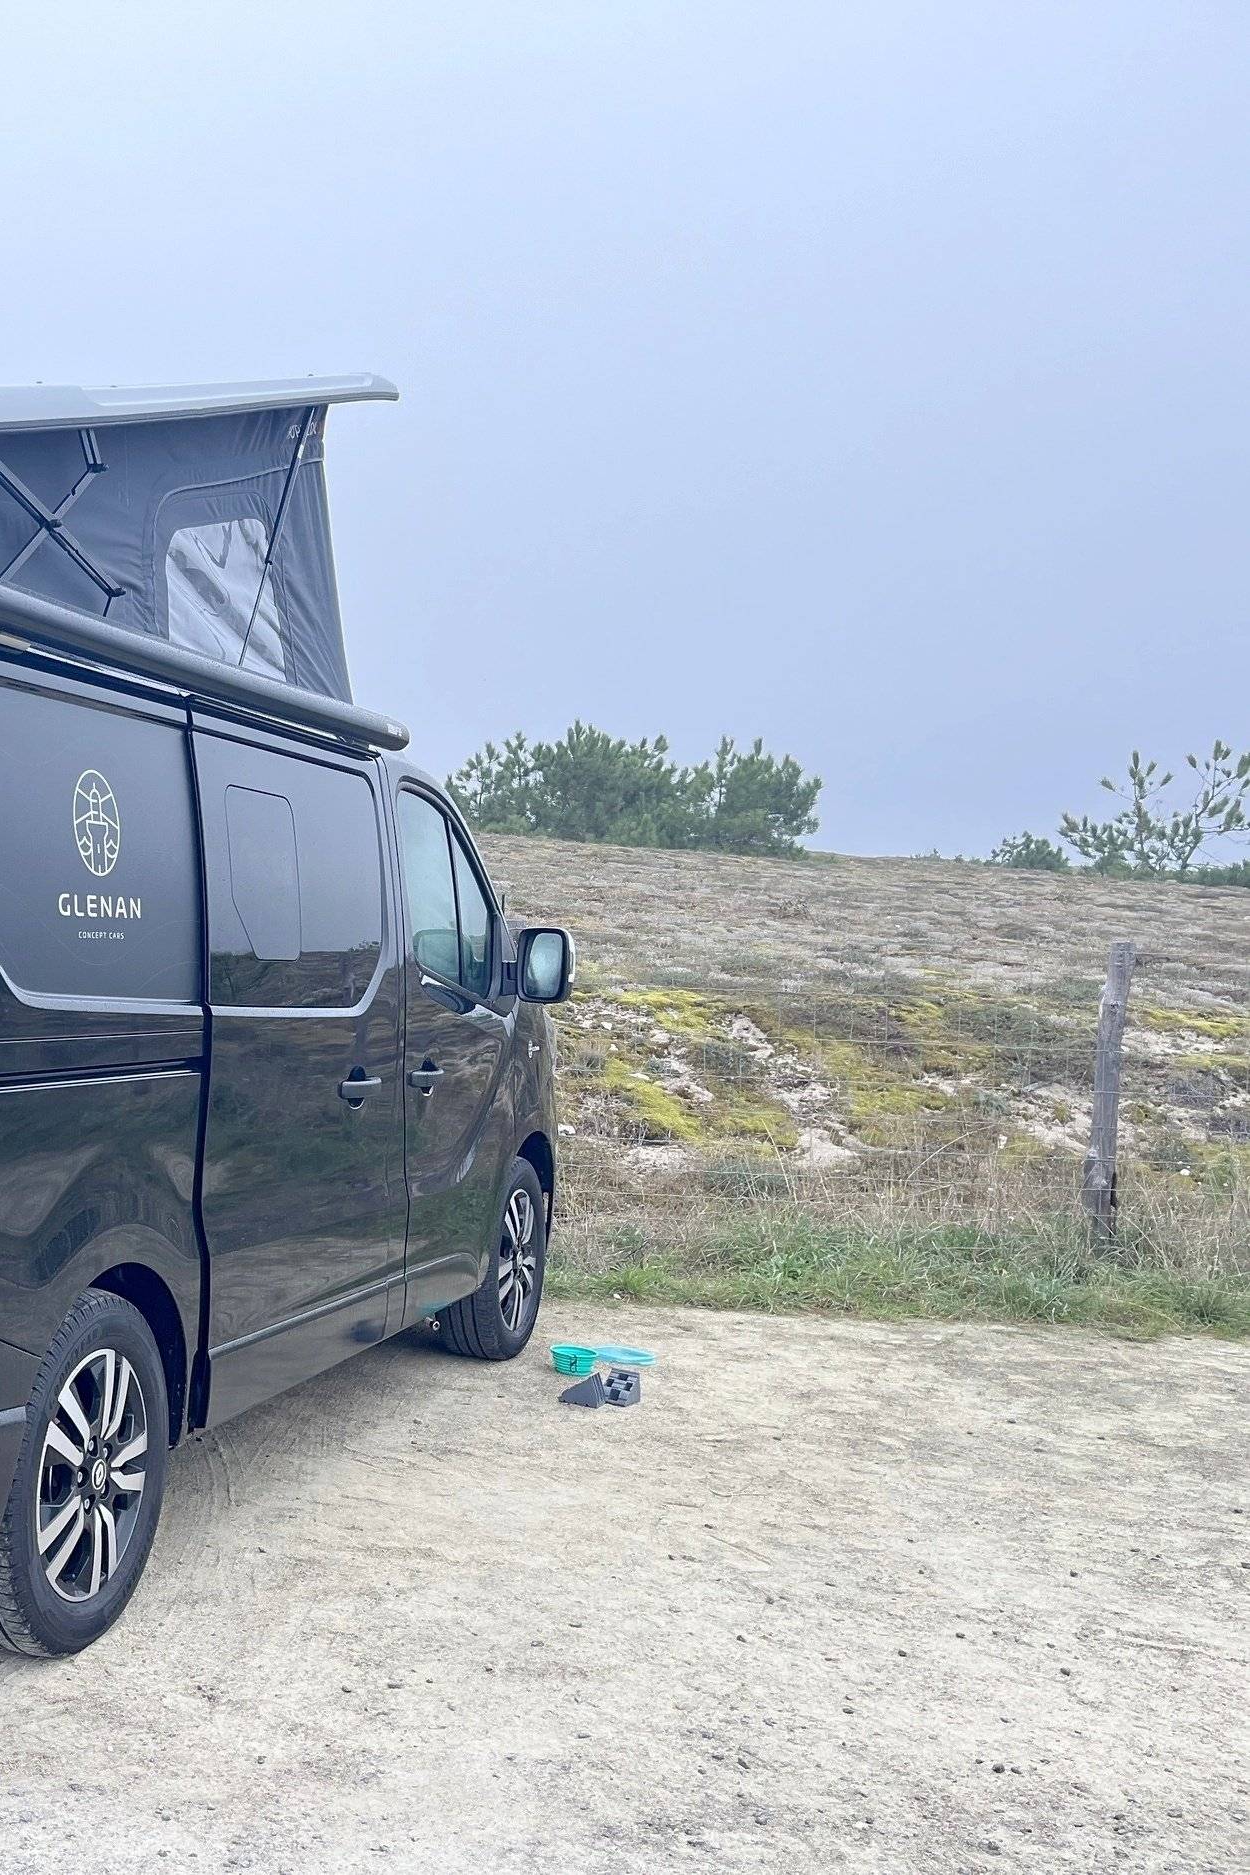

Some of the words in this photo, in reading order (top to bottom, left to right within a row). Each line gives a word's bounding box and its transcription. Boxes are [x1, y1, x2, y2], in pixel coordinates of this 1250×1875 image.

[58, 893, 142, 919] GLENAN
[78, 930, 107, 939] CONCEPT
[108, 931, 125, 940] CARS
